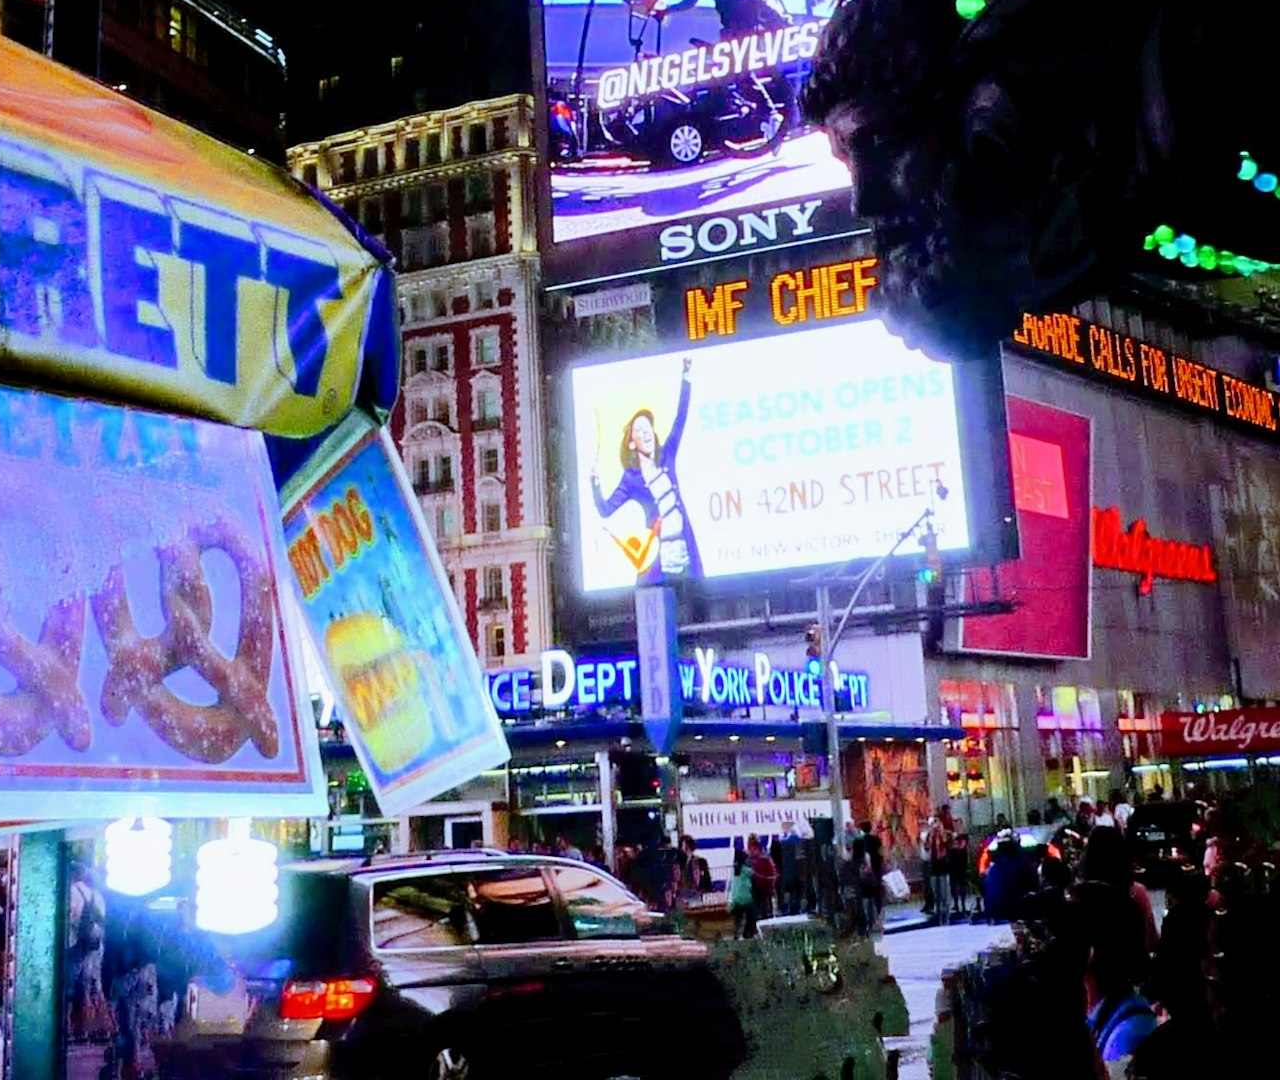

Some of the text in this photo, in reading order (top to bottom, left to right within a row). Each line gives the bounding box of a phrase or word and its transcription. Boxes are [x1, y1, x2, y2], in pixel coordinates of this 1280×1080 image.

[597, 18, 828, 109] @NIGELSYLVES
[658, 199, 823, 262] SONY
[577, 289, 649, 314] SHERWOOD
[687, 259, 878, 341] IMF CHIEF
[698, 367, 946, 431] SEASON OPENS
[1088, 324, 1136, 381] CALLS
[1140, 344, 1169, 394] FOR
[1172, 356, 1220, 411] URGENT
[1222, 374, 1277, 431] ECONOMIC
[732, 413, 913, 467] OCTOBER 2
[708, 460, 946, 522] ON 42ND STREET
[717, 547, 745, 561] THE
[750, 542, 788, 558] NEW
[795, 534, 861, 553] VICTORY
[541, 649, 637, 711] DEPT
[695, 647, 751, 705] YORK
[754, 652, 820, 706] POLICE
